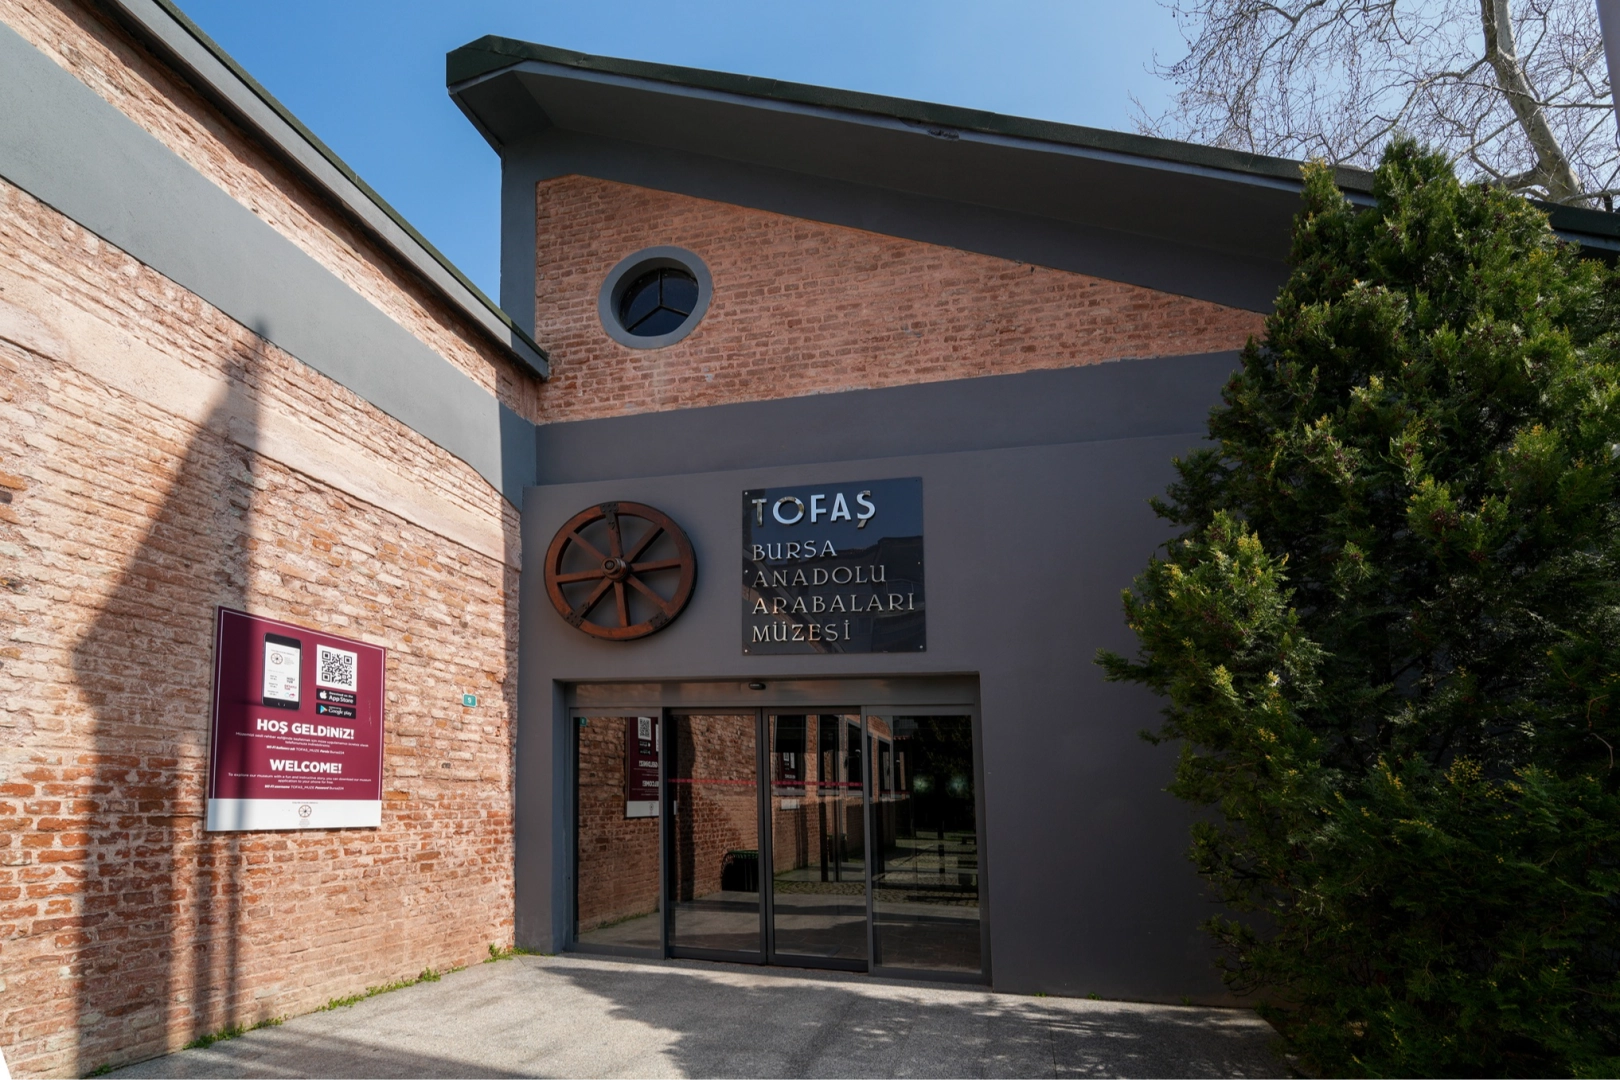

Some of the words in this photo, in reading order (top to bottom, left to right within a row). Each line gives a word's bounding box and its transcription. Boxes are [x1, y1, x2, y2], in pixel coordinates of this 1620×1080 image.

[752, 490, 876, 528] TOFAŞ
[752, 540, 837, 561] BURSA
[752, 565, 886, 588] ANADOLU
[752, 592, 915, 615] ARABALARI
[752, 619, 851, 643] MÜZESİ
[257, 719, 288, 734] HOŞ
[292, 723, 354, 739] GELDİNİZ!
[270, 759, 342, 773] WELCOME!
